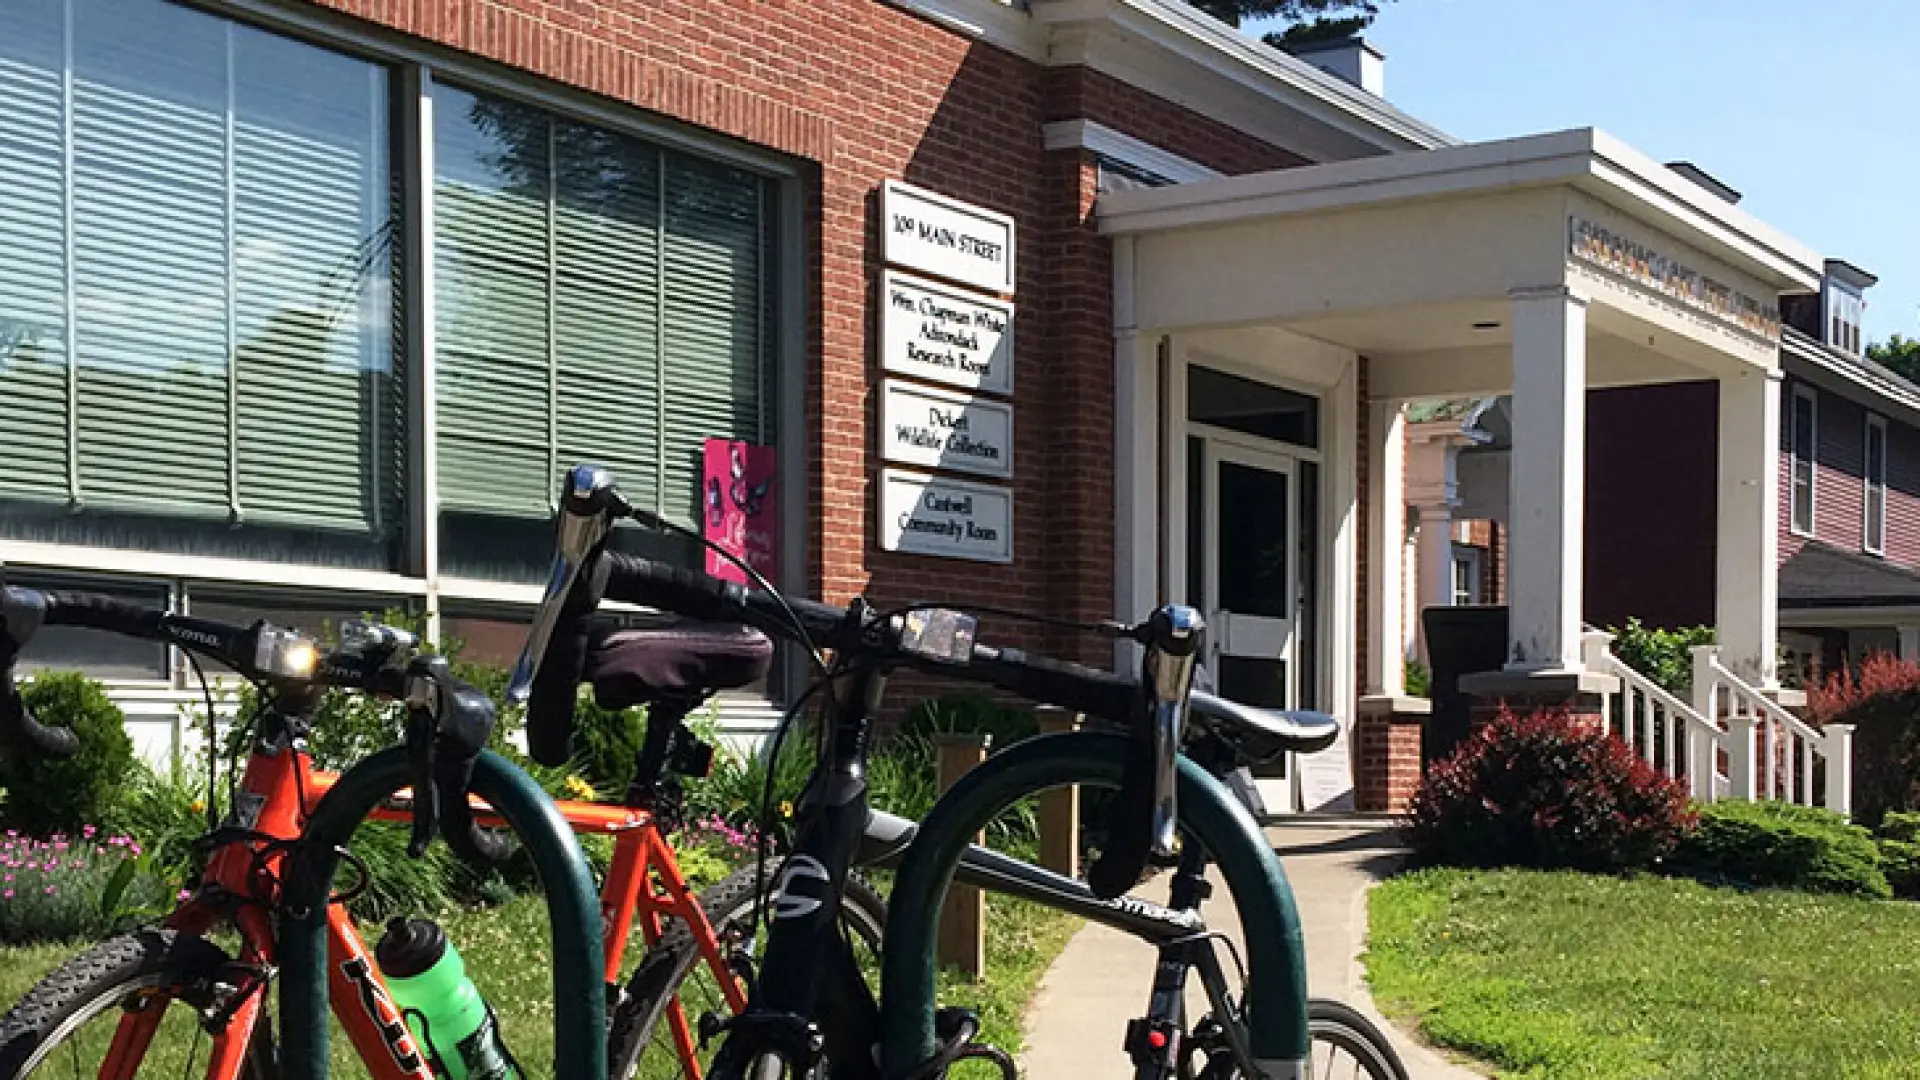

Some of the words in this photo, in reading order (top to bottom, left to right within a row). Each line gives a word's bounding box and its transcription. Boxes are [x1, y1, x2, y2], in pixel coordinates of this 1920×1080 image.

[892, 213, 915, 236] 109
[918, 220, 956, 248] MAIN
[958, 234, 1002, 263] STREET
[918, 297, 970, 325] Chapman
[919, 321, 980, 351] Adirondack
[906, 340, 957, 369] Research
[958, 352, 991, 376] Room
[945, 434, 999, 459] Collection
[898, 511, 964, 543] Community
[966, 521, 999, 541] Room
